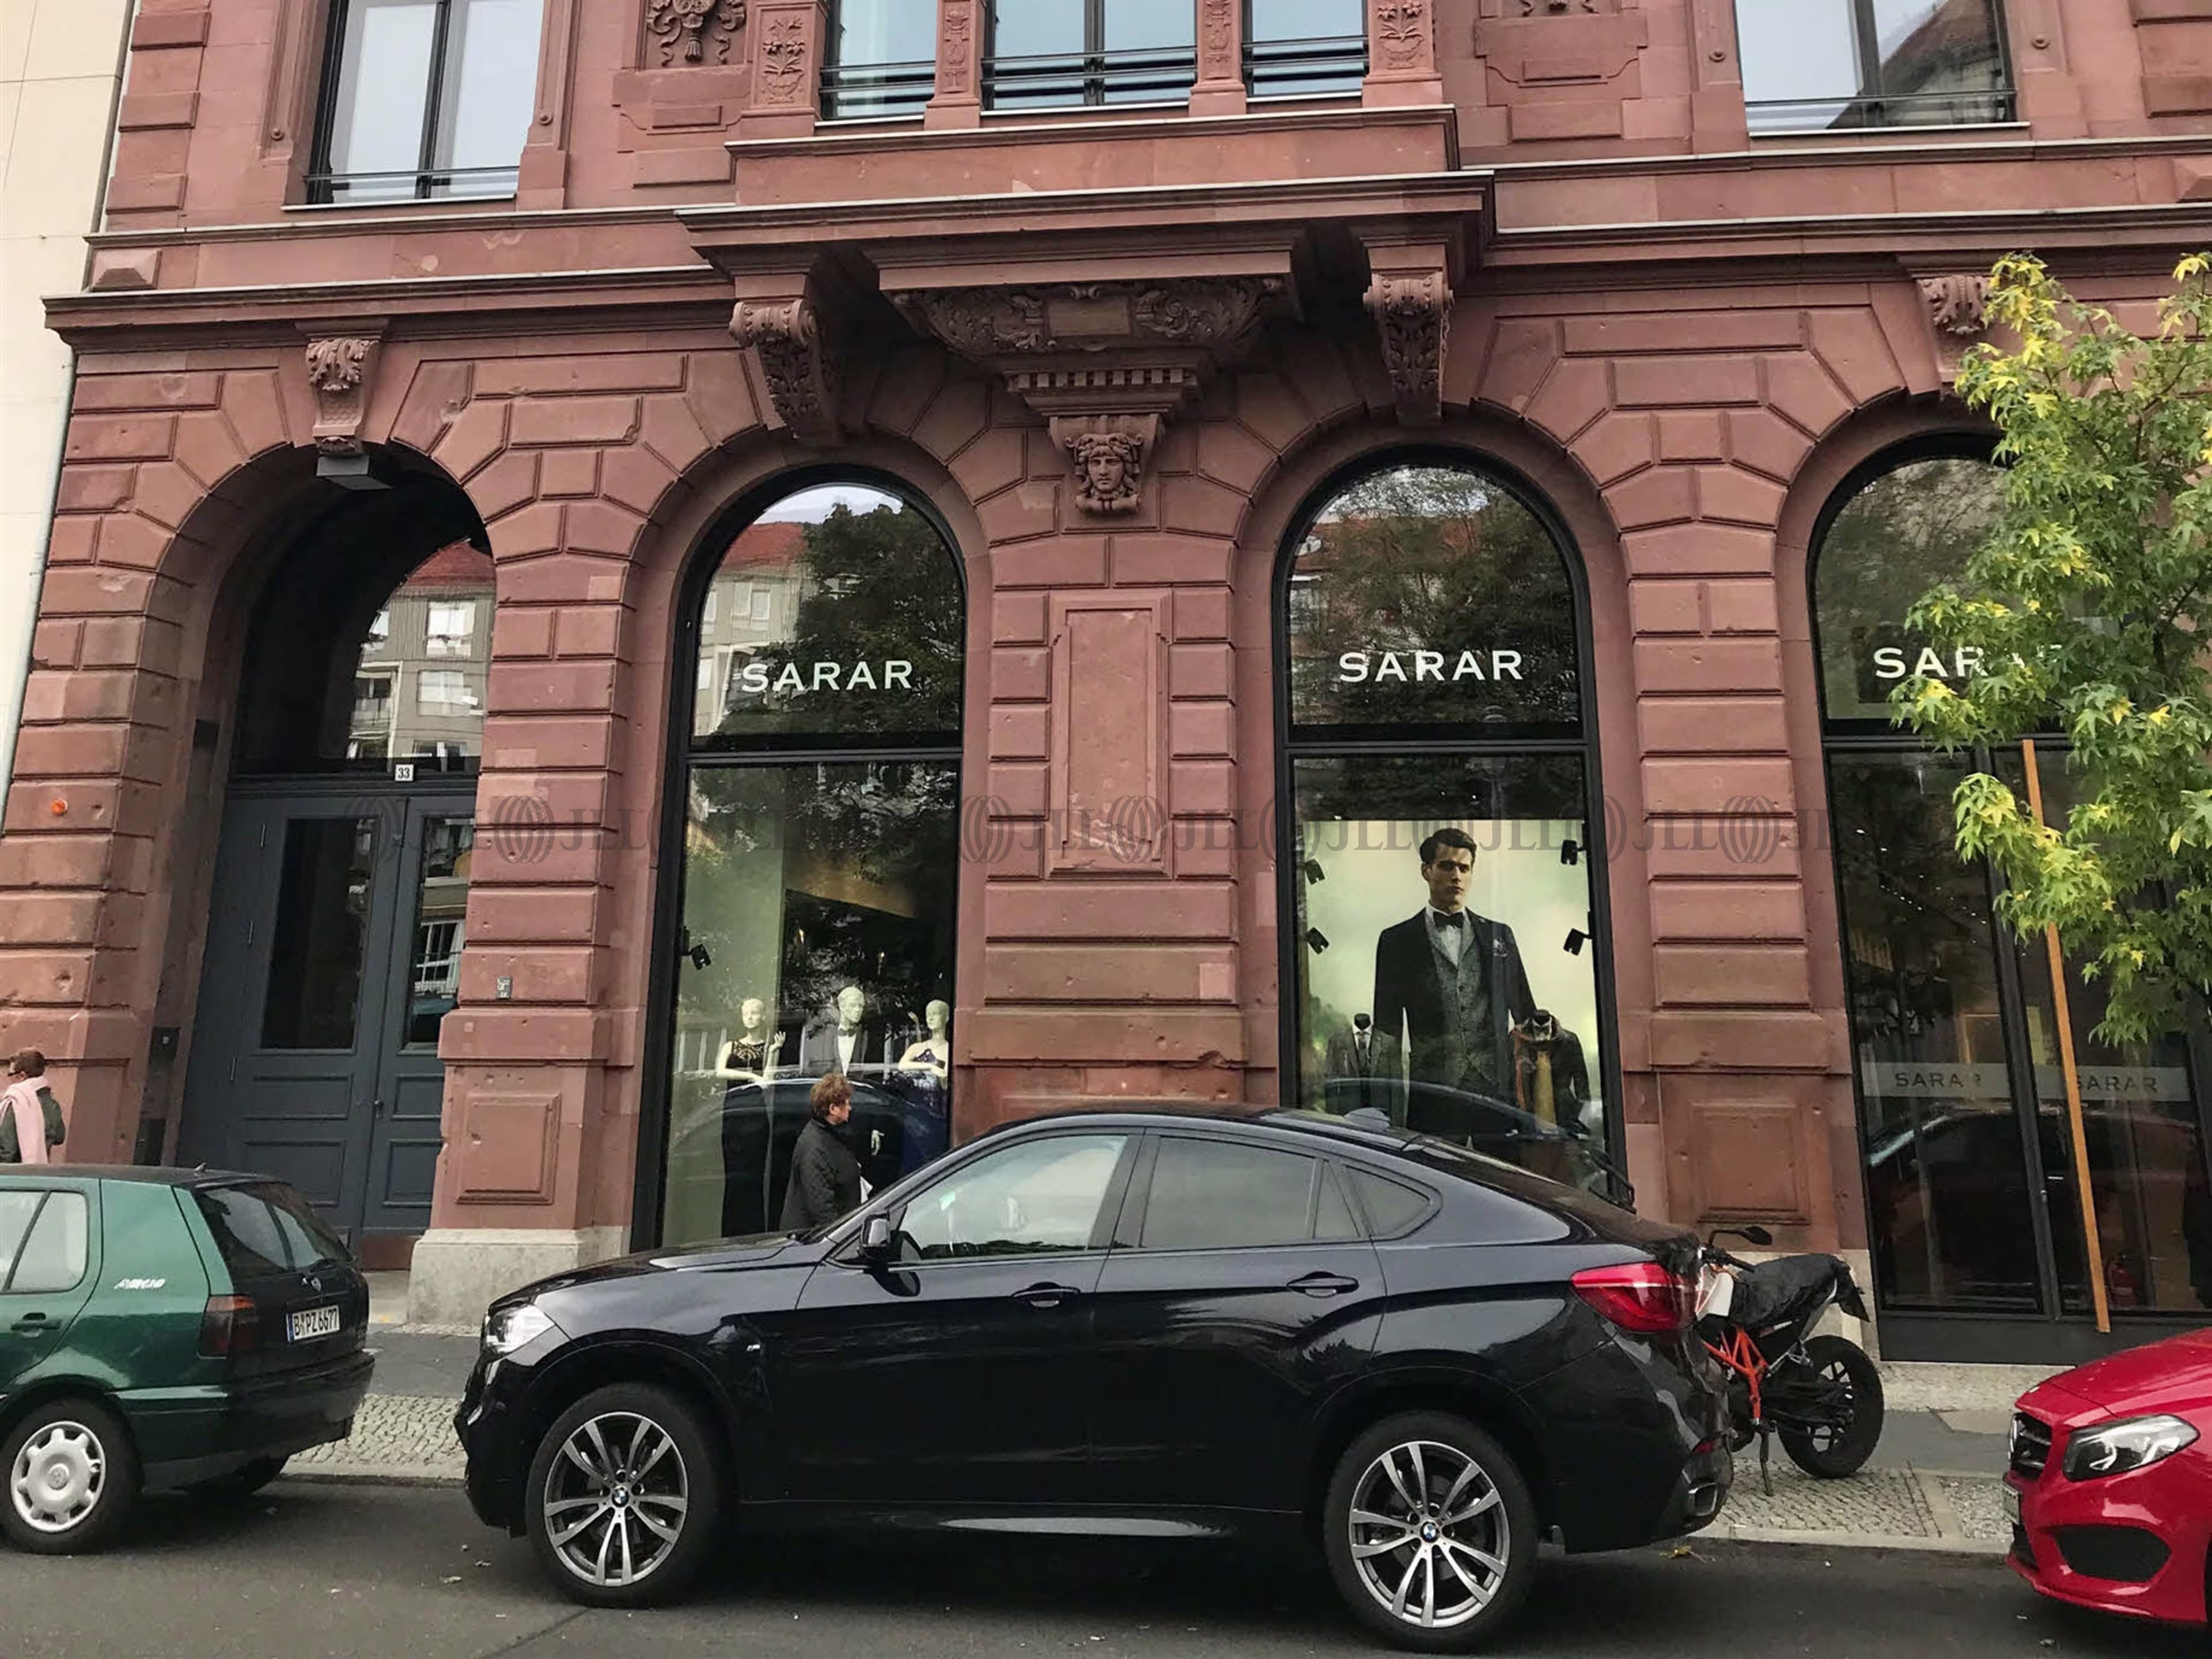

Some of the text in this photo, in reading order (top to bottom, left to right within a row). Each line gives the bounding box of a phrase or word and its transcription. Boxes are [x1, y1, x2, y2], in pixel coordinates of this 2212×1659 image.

[741, 660, 912, 692] SARAR
[1339, 650, 1522, 682] SARAR
[397, 767, 410, 779] 33
